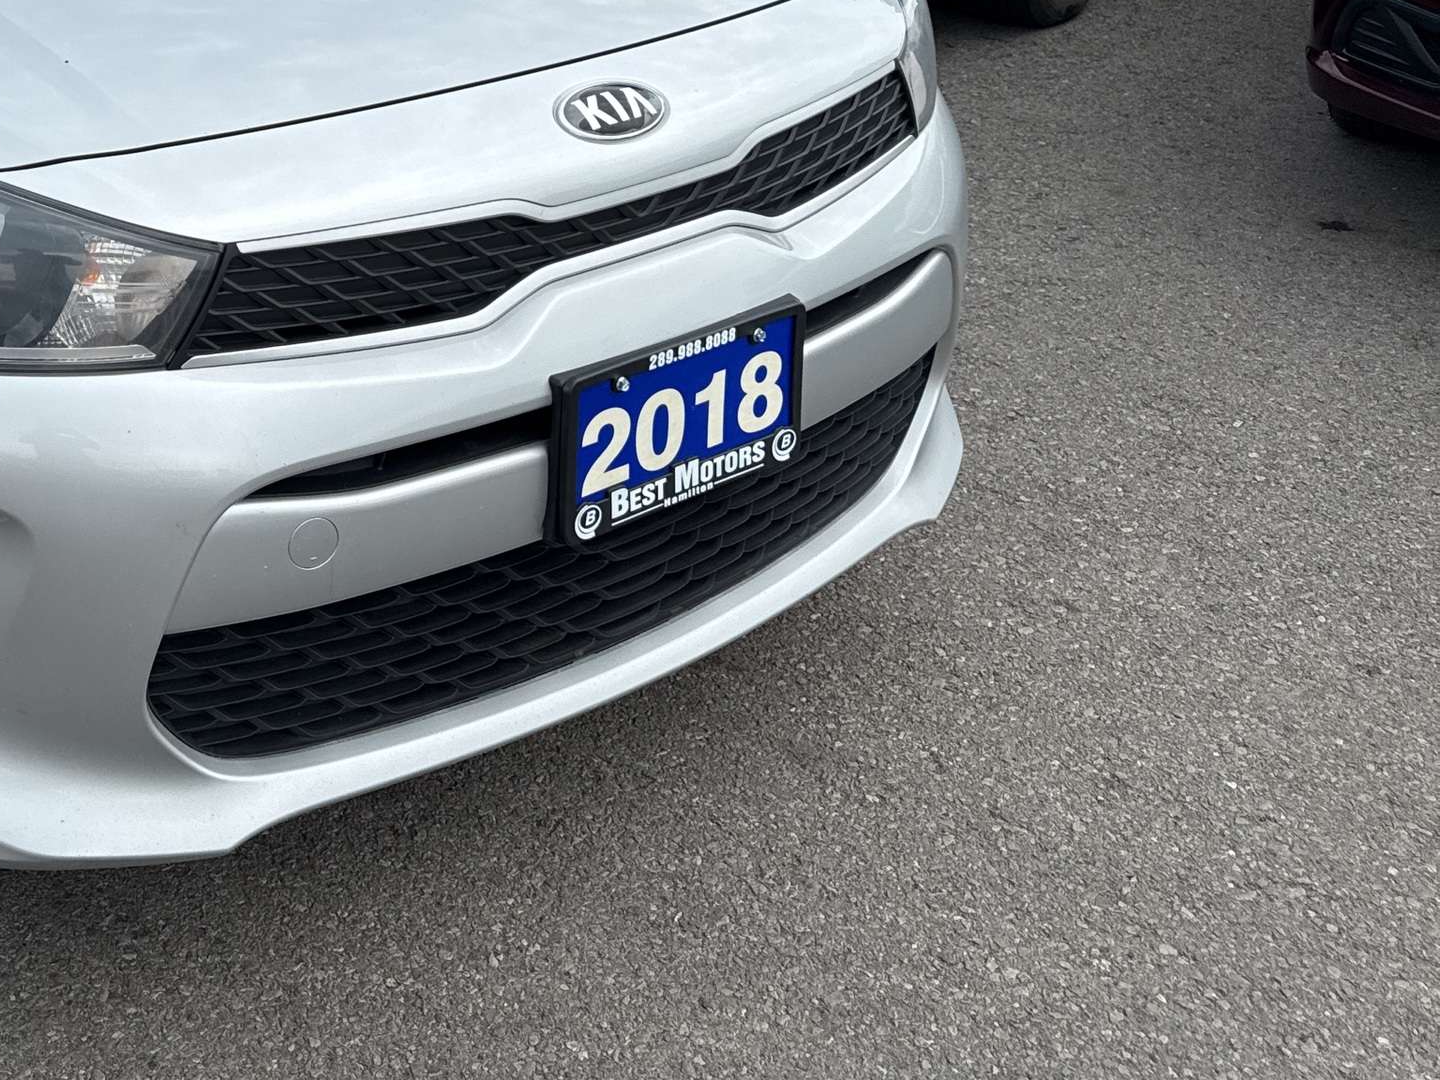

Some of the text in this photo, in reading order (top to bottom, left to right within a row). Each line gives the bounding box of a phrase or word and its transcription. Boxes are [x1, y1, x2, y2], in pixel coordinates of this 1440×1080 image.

[570, 87, 657, 131] KIA
[648, 327, 736, 370] 289.988.8088
[581, 351, 783, 498] 2018
[611, 441, 765, 519] BEST MOTORS
[664, 481, 714, 507] Hamilton
